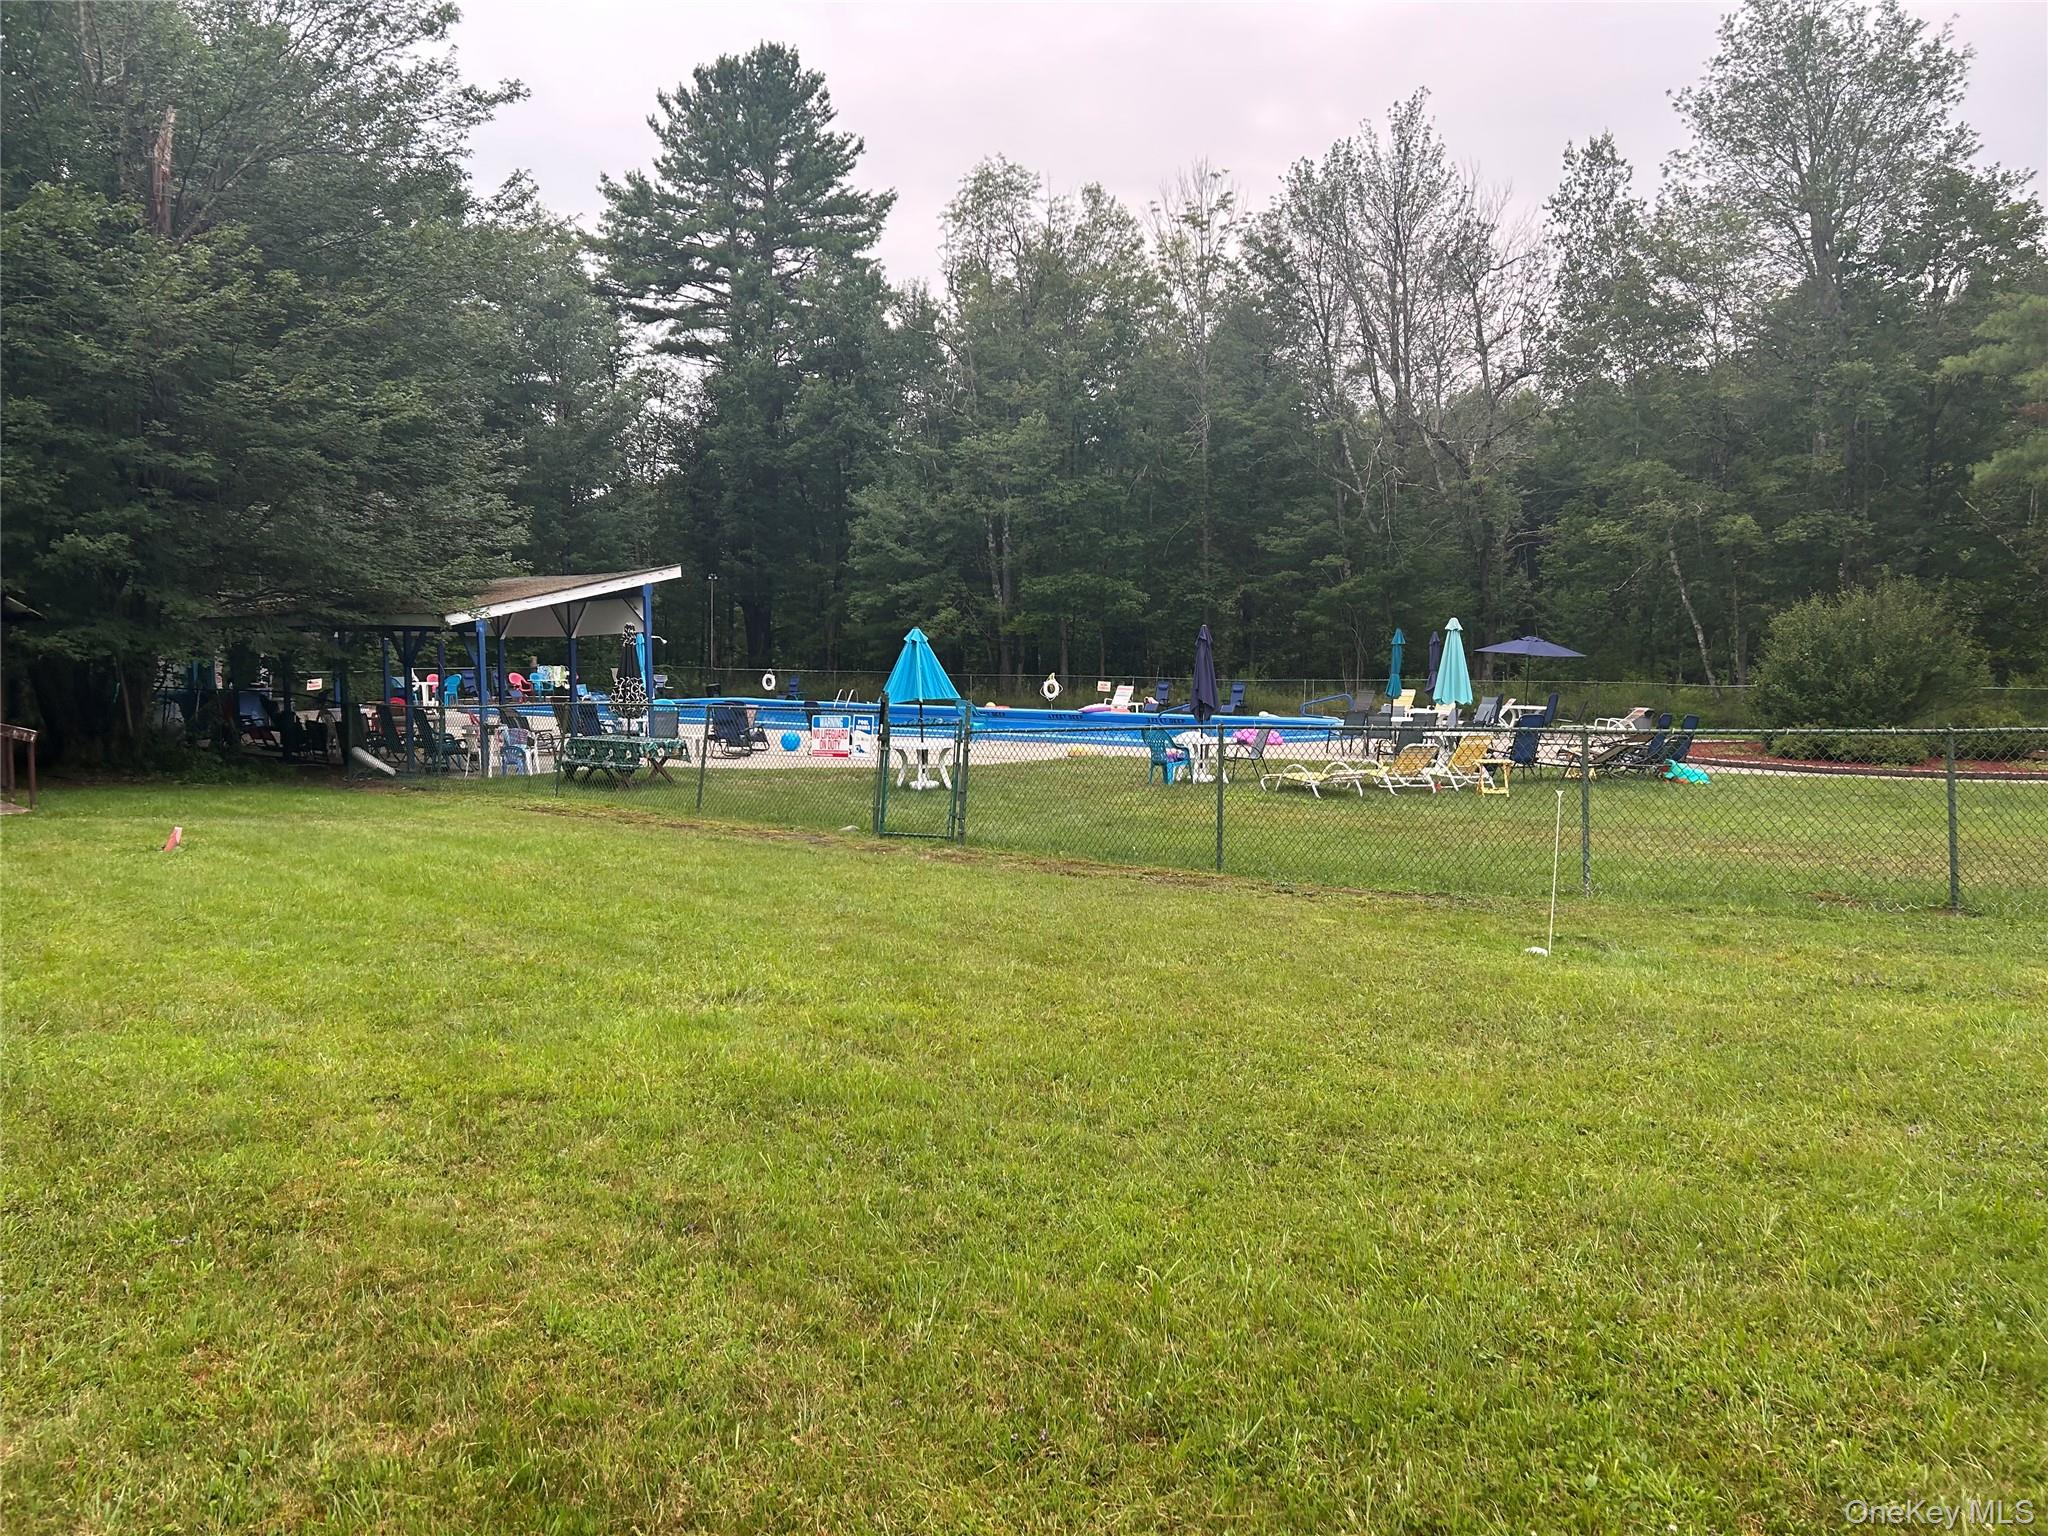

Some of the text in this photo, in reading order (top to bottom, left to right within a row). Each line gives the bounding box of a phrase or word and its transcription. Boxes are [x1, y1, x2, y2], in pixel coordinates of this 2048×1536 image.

[819, 717, 843, 728] WARNING
[812, 729, 820, 739] NO
[820, 729, 848, 740] LIFEGUARD
[819, 739, 840, 749] ON DUTY
